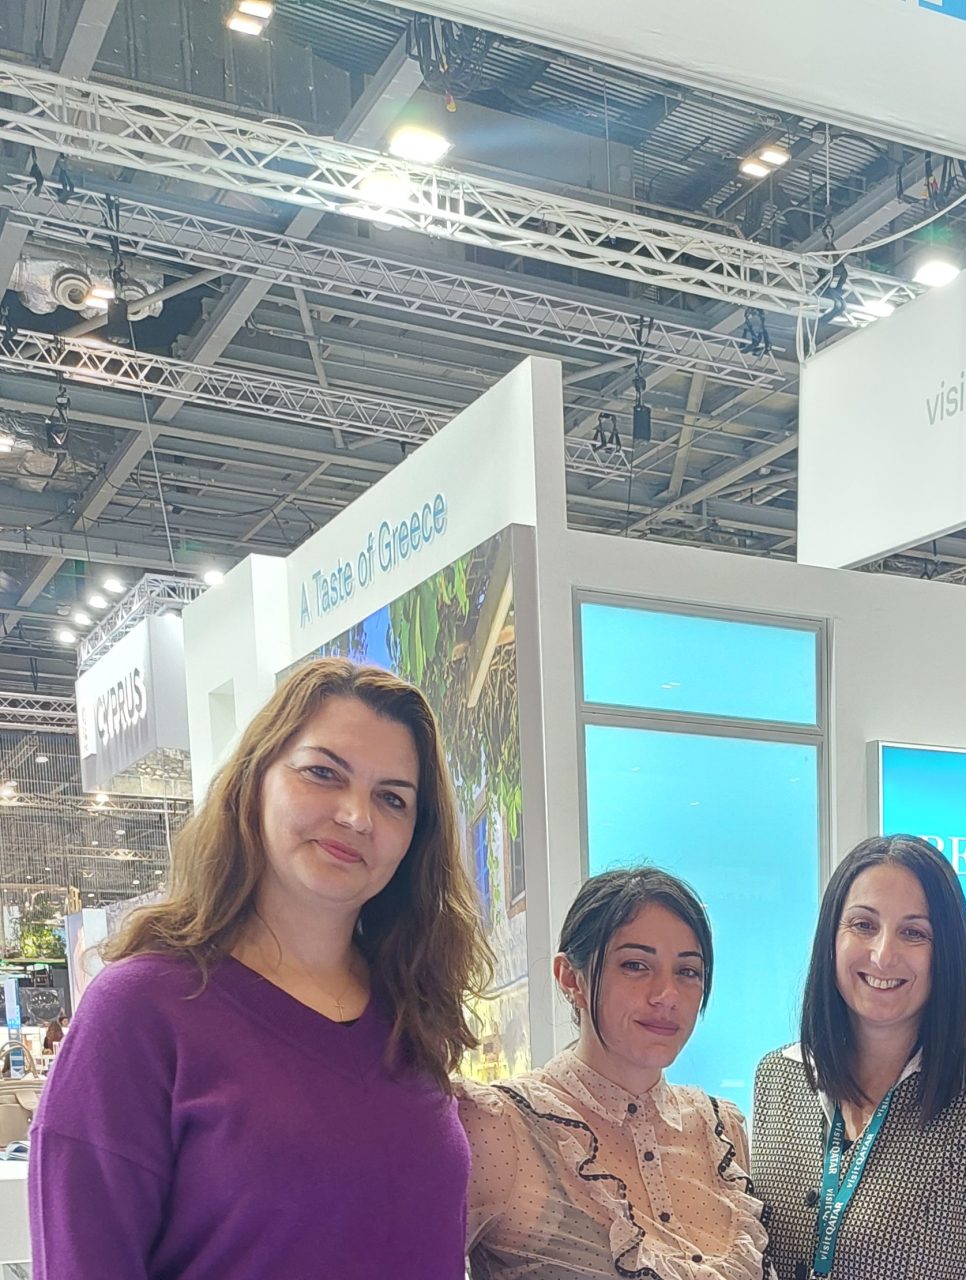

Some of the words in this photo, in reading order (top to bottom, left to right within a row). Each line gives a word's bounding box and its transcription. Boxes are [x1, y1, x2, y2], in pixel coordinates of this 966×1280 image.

[300, 581, 312, 628] A
[312, 557, 353, 617] Taste
[358, 532, 375, 587] of
[378, 493, 447, 573] Greece
[96, 667, 147, 746] CYPRUS
